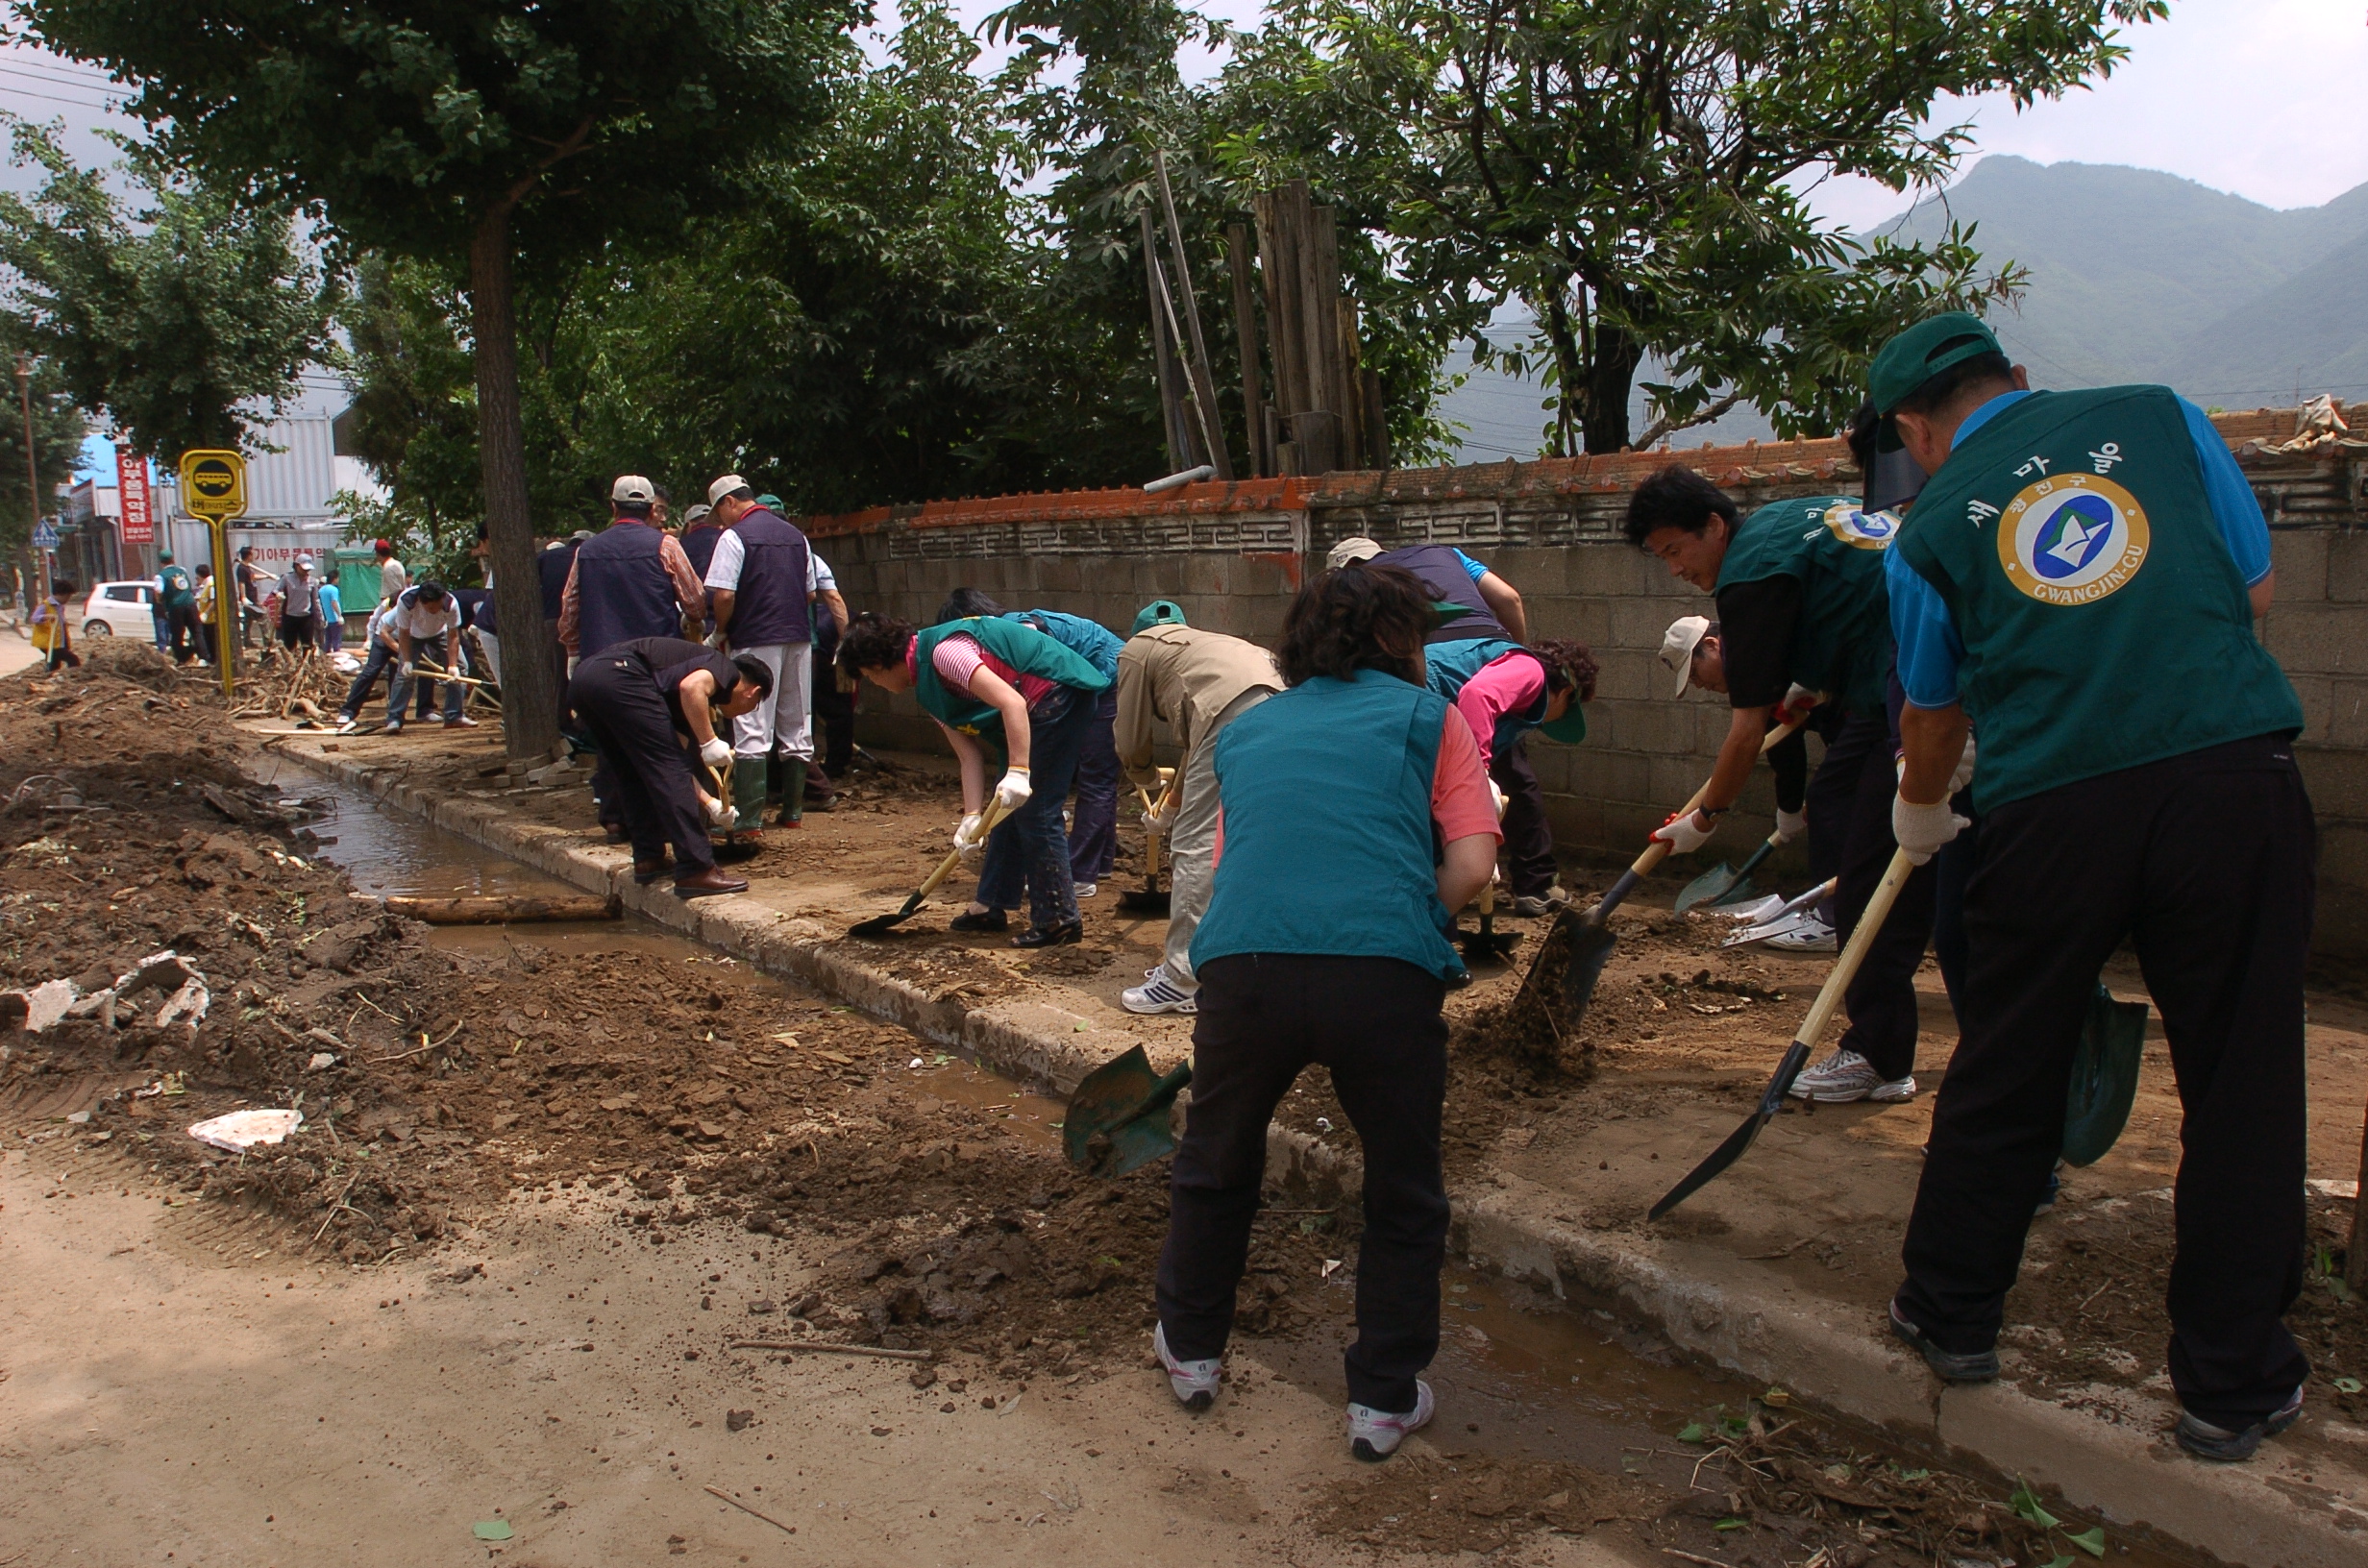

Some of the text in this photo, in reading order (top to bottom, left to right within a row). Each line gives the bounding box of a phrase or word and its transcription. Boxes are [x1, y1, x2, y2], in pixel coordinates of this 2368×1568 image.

[1966, 442, 2123, 528] 새마을
[2010, 476, 2087, 515] 광진구
[2034, 545, 2143, 603] GWANGJIN-GU
